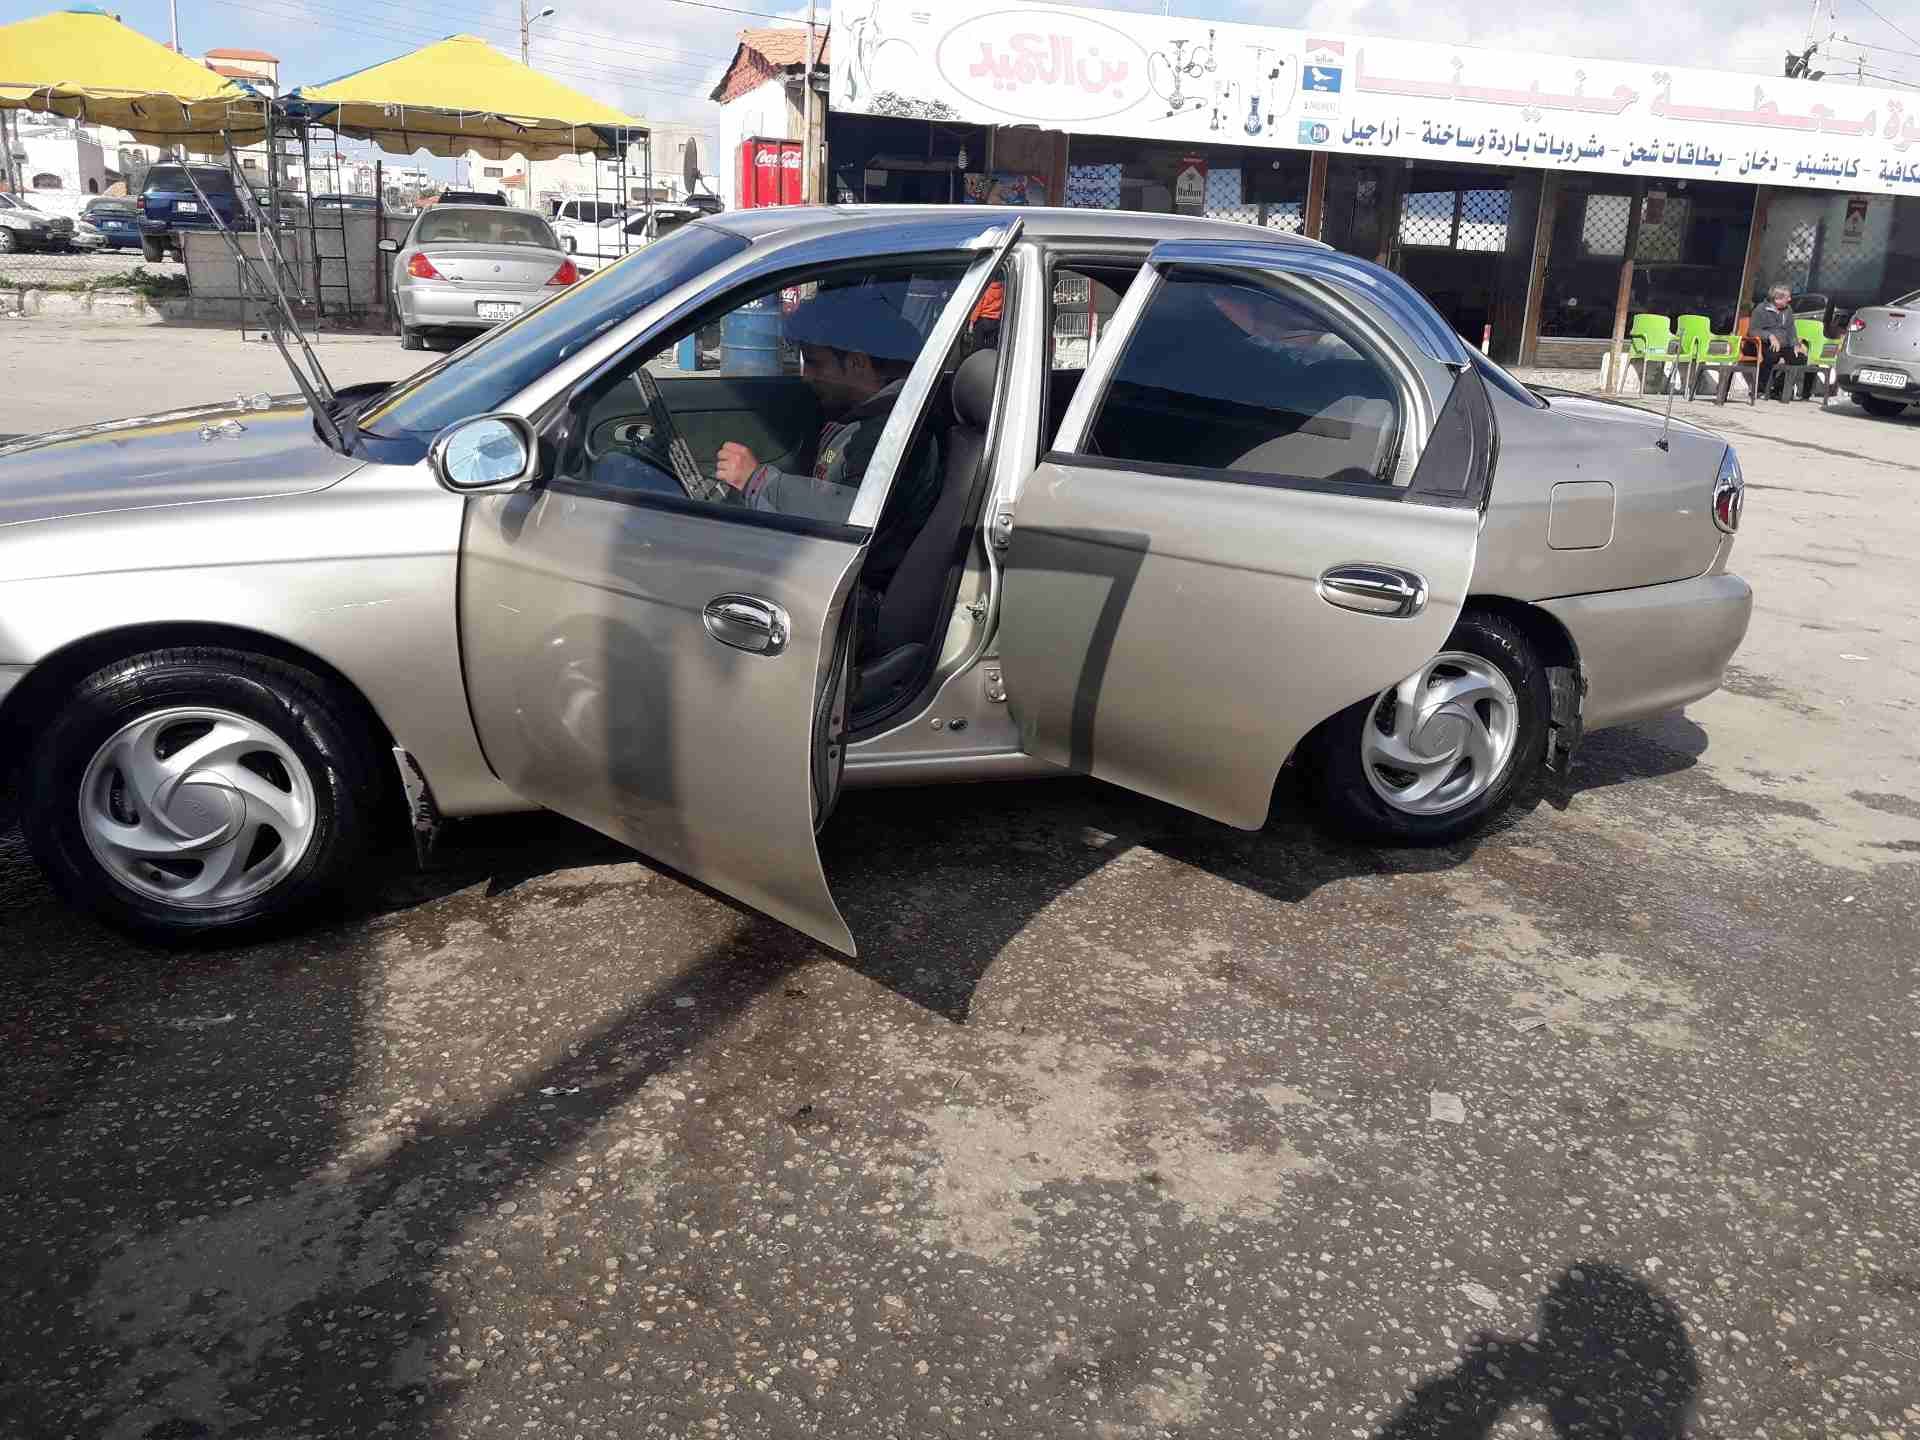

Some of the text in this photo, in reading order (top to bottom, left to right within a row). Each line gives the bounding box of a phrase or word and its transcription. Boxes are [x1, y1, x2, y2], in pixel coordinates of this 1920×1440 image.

[1077, 47, 1130, 98] بن
[1650, 71, 1877, 137] محطة
[1422, 120, 1485, 154] وساخنة
[1488, 128, 1530, 160] باردة
[1534, 132, 1605, 163] مشروبات
[1622, 138, 1659, 167] شحن
[1662, 142, 1723, 176] بطاقات
[1738, 149, 1778, 176] دخان
[1792, 153, 1861, 184] كابتشينو
